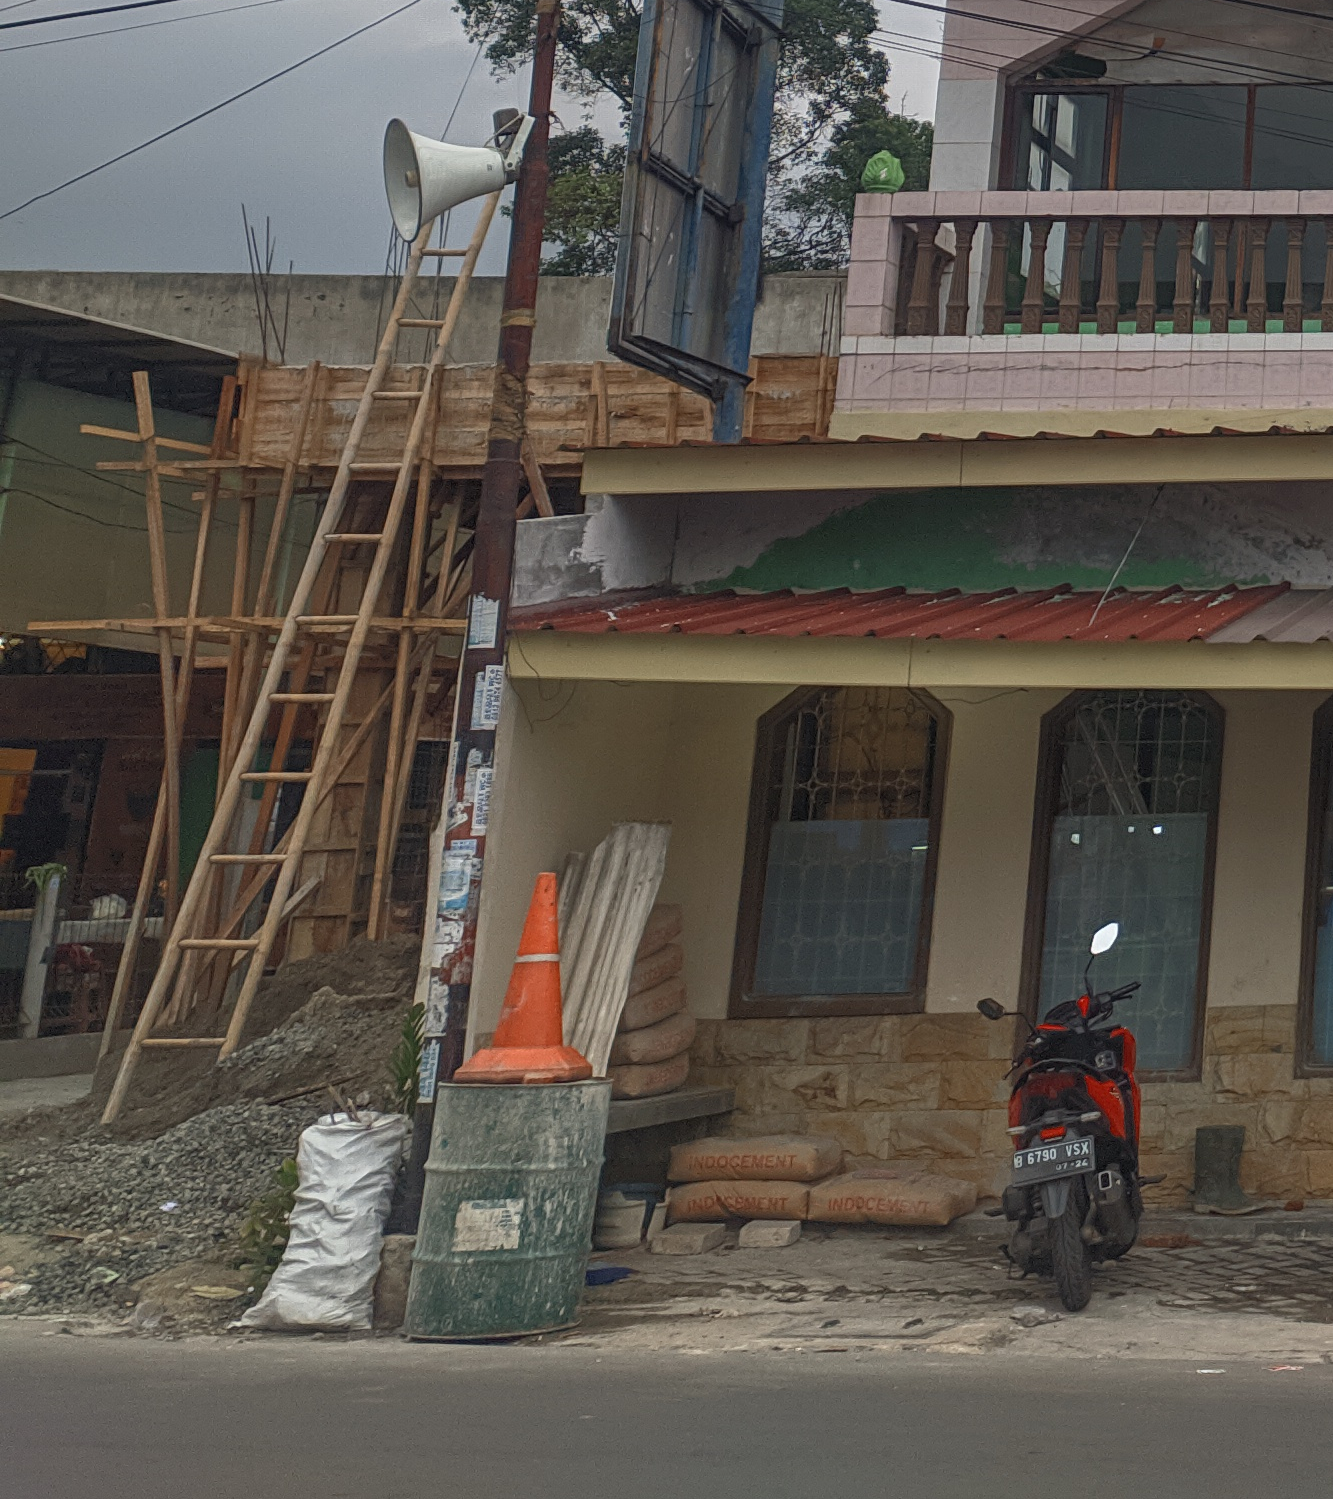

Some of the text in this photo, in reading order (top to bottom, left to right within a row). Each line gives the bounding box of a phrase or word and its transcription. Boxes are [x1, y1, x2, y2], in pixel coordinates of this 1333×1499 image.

[688, 1154, 798, 1170] INDOCEMENT
[1014, 1141, 1089, 1169] B 6790 VSX
[827, 1197, 930, 1214] INDOCEMENT
